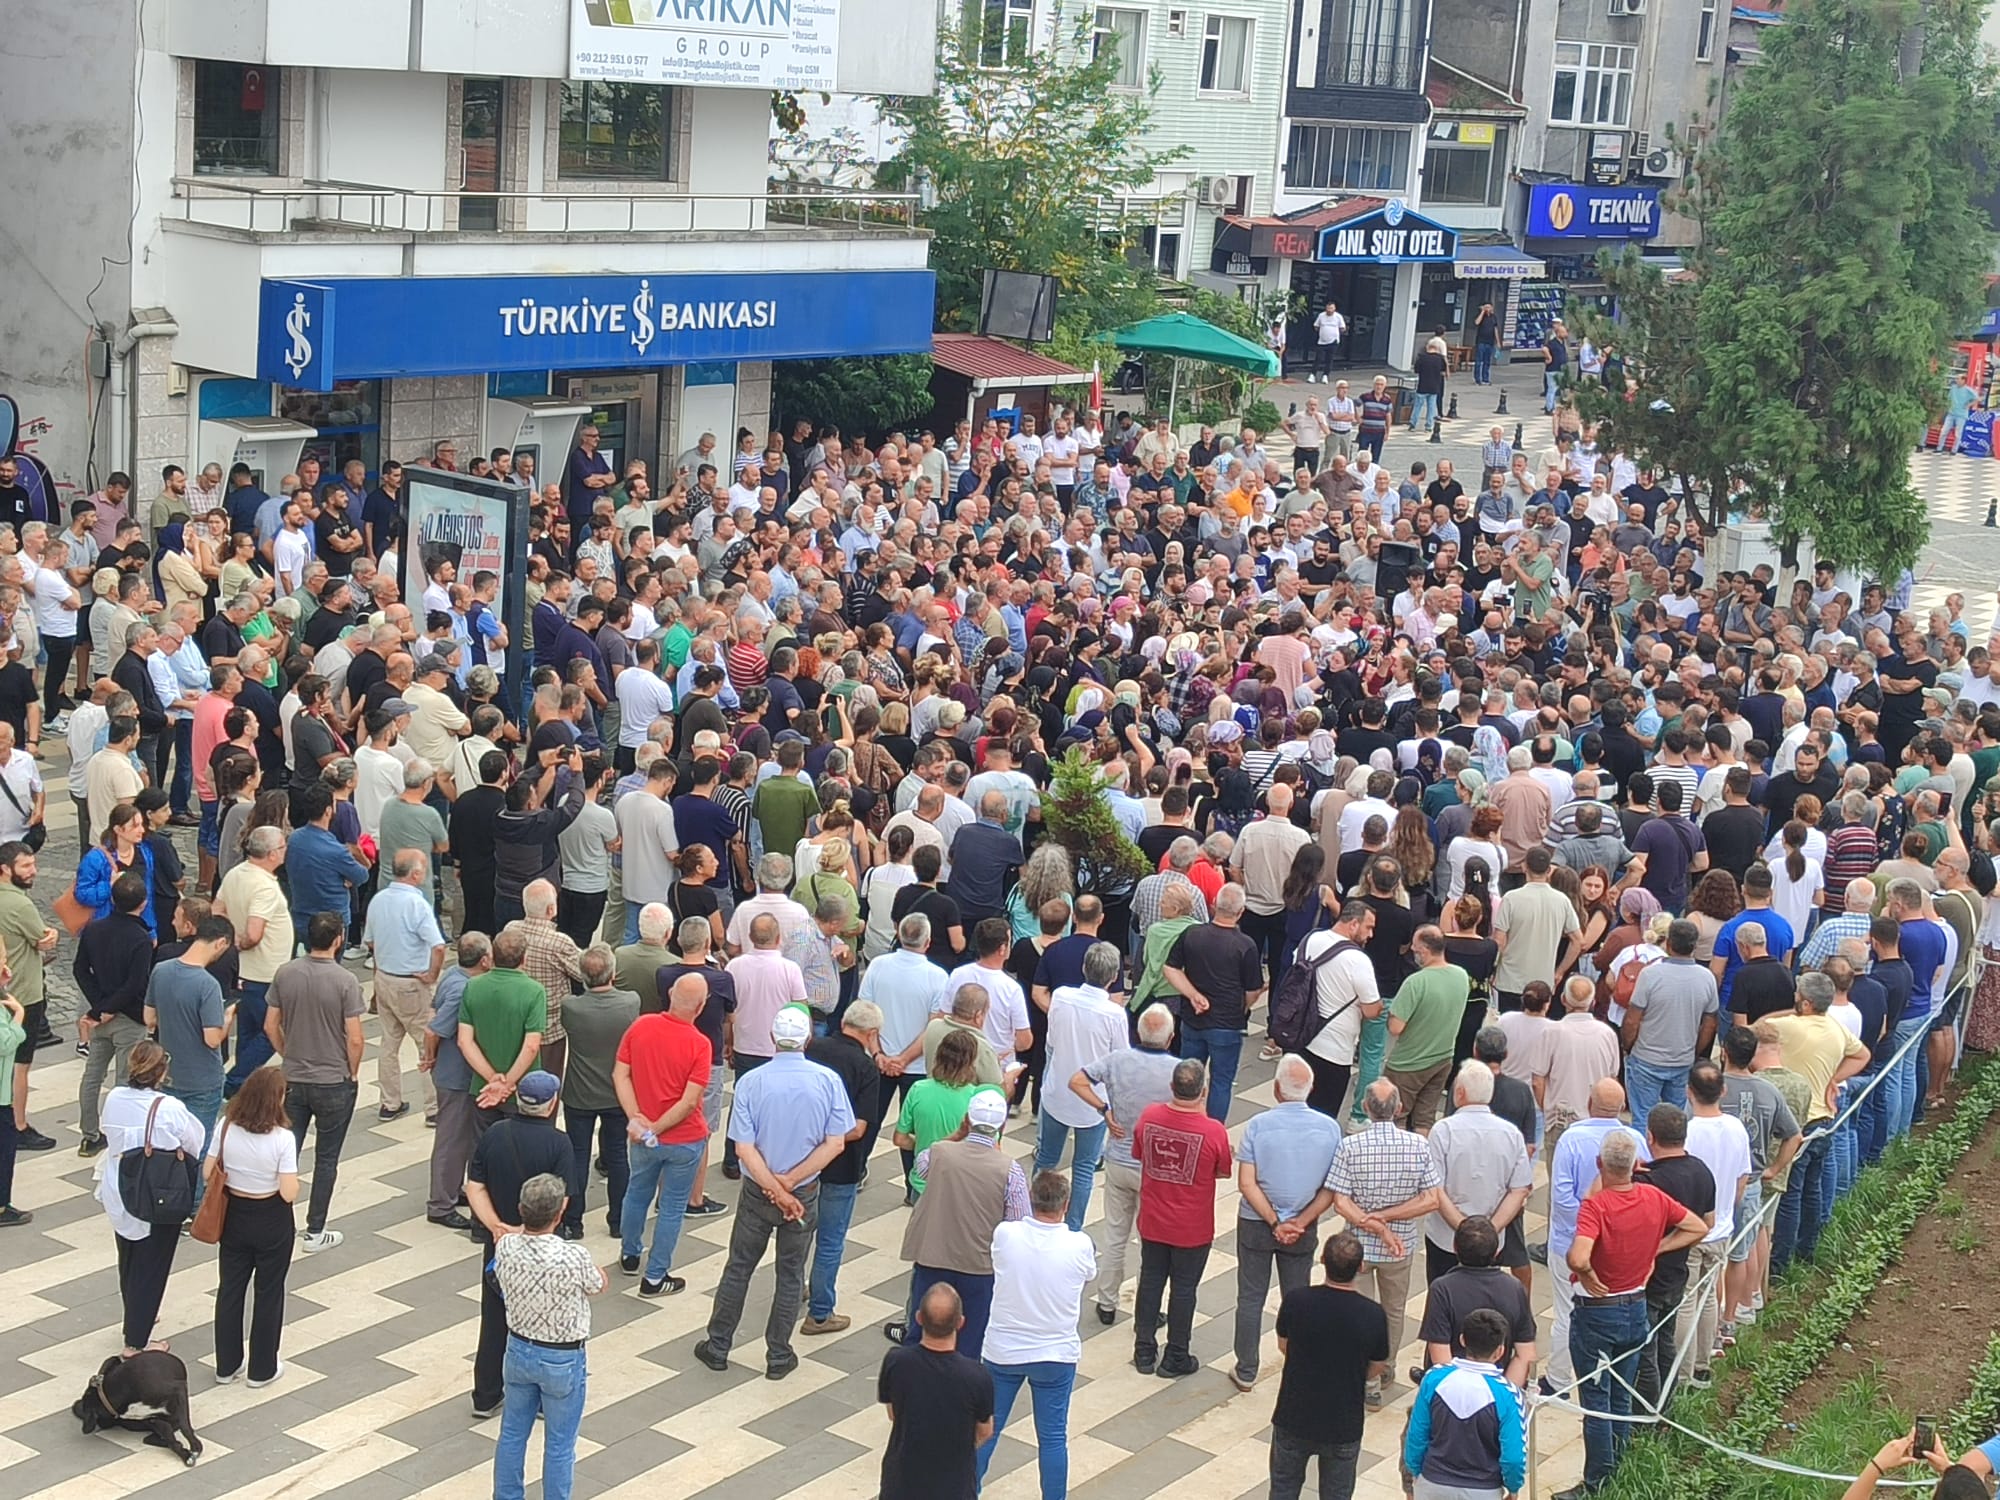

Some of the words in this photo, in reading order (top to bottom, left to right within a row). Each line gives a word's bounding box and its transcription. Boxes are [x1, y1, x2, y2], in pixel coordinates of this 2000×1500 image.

[576, 52, 591, 63] +90
[593, 53, 609, 63] 212
[610, 55, 625, 65] 951
[627, 55, 633, 65] 0
[634, 56, 648, 66] 577
[676, 37, 770, 58] GROUP
[804, 65, 820, 74] GSM
[1589, 193, 1654, 224] TEKNİK
[1334, 229, 1367, 256] ANL
[1410, 229, 1445, 256] OTEL
[500, 297, 626, 336] TÜRKİYE
[660, 300, 777, 331] BANKASI
[435, 508, 484, 550] AĞUSTOS
